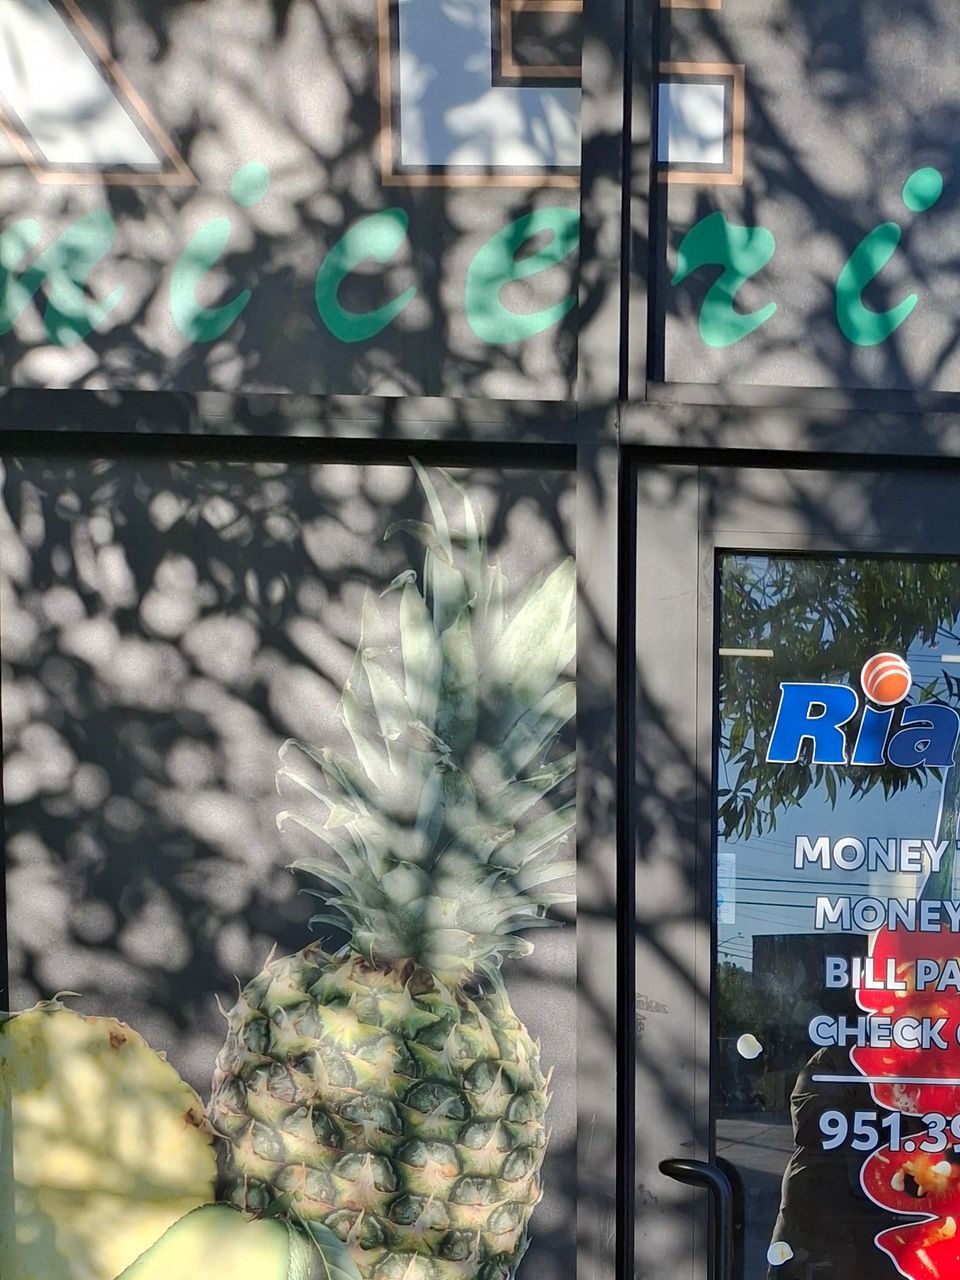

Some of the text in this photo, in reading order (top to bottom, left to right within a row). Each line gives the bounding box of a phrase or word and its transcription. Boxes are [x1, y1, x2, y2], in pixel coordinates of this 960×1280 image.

[765, 652, 960, 769] Ria
[793, 835, 949, 873] MONEY
[825, 954, 907, 990] BILL
[808, 1015, 948, 1050] CHECK
